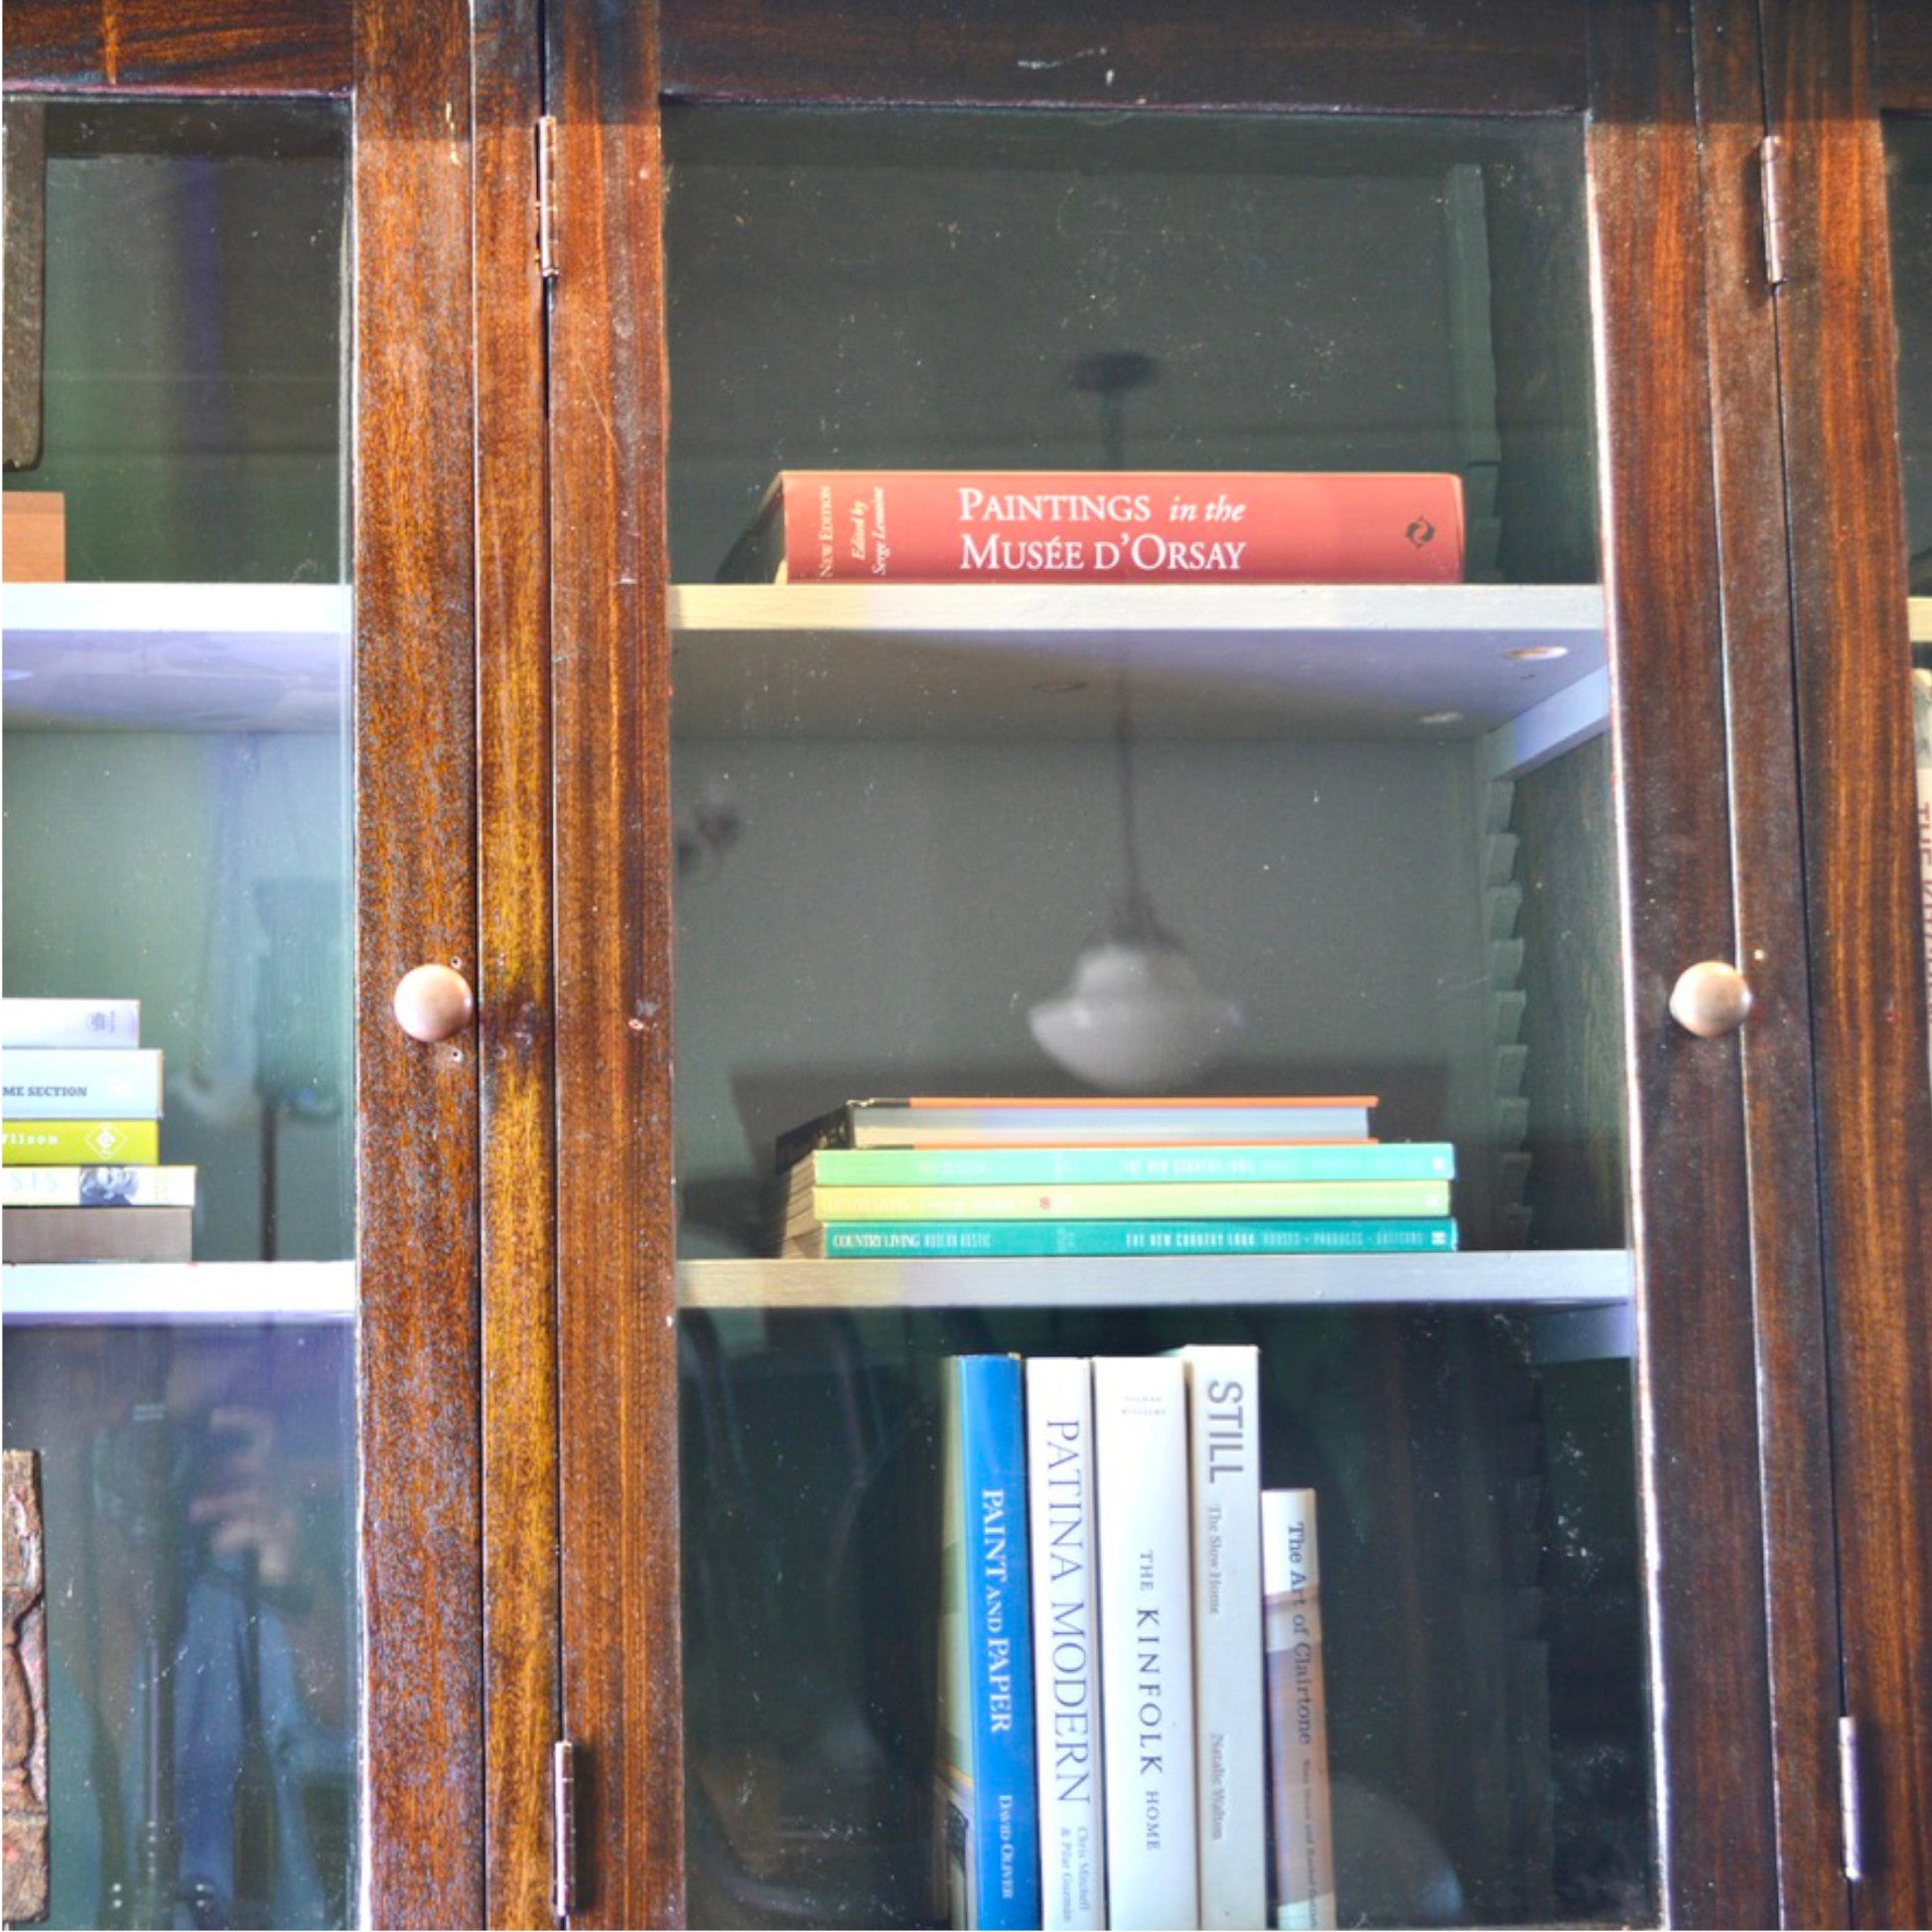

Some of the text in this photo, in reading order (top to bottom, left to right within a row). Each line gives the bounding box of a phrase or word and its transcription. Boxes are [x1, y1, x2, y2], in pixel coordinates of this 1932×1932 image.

[849, 500, 870, 561] Edited by
[957, 487, 1246, 522] PAINTINGS in the
[958, 532, 1085, 571] MUSÉE
[2, 1086, 88, 1097] ME SECTION
[1207, 1379, 1245, 1484] STILL
[982, 1488, 1013, 1734] PAINT AND PAPER
[1046, 1419, 1091, 1805] PATINA MODERN
[1208, 1504, 1223, 1615] The Slow Home
[1287, 1521, 1314, 1745] The Art of Clairtone
[1137, 1550, 1165, 1852] THE KINFOLK HOME
[998, 1794, 1015, 1899] DAVID OLIVER
[1076, 1826, 1089, 1860] Chris
